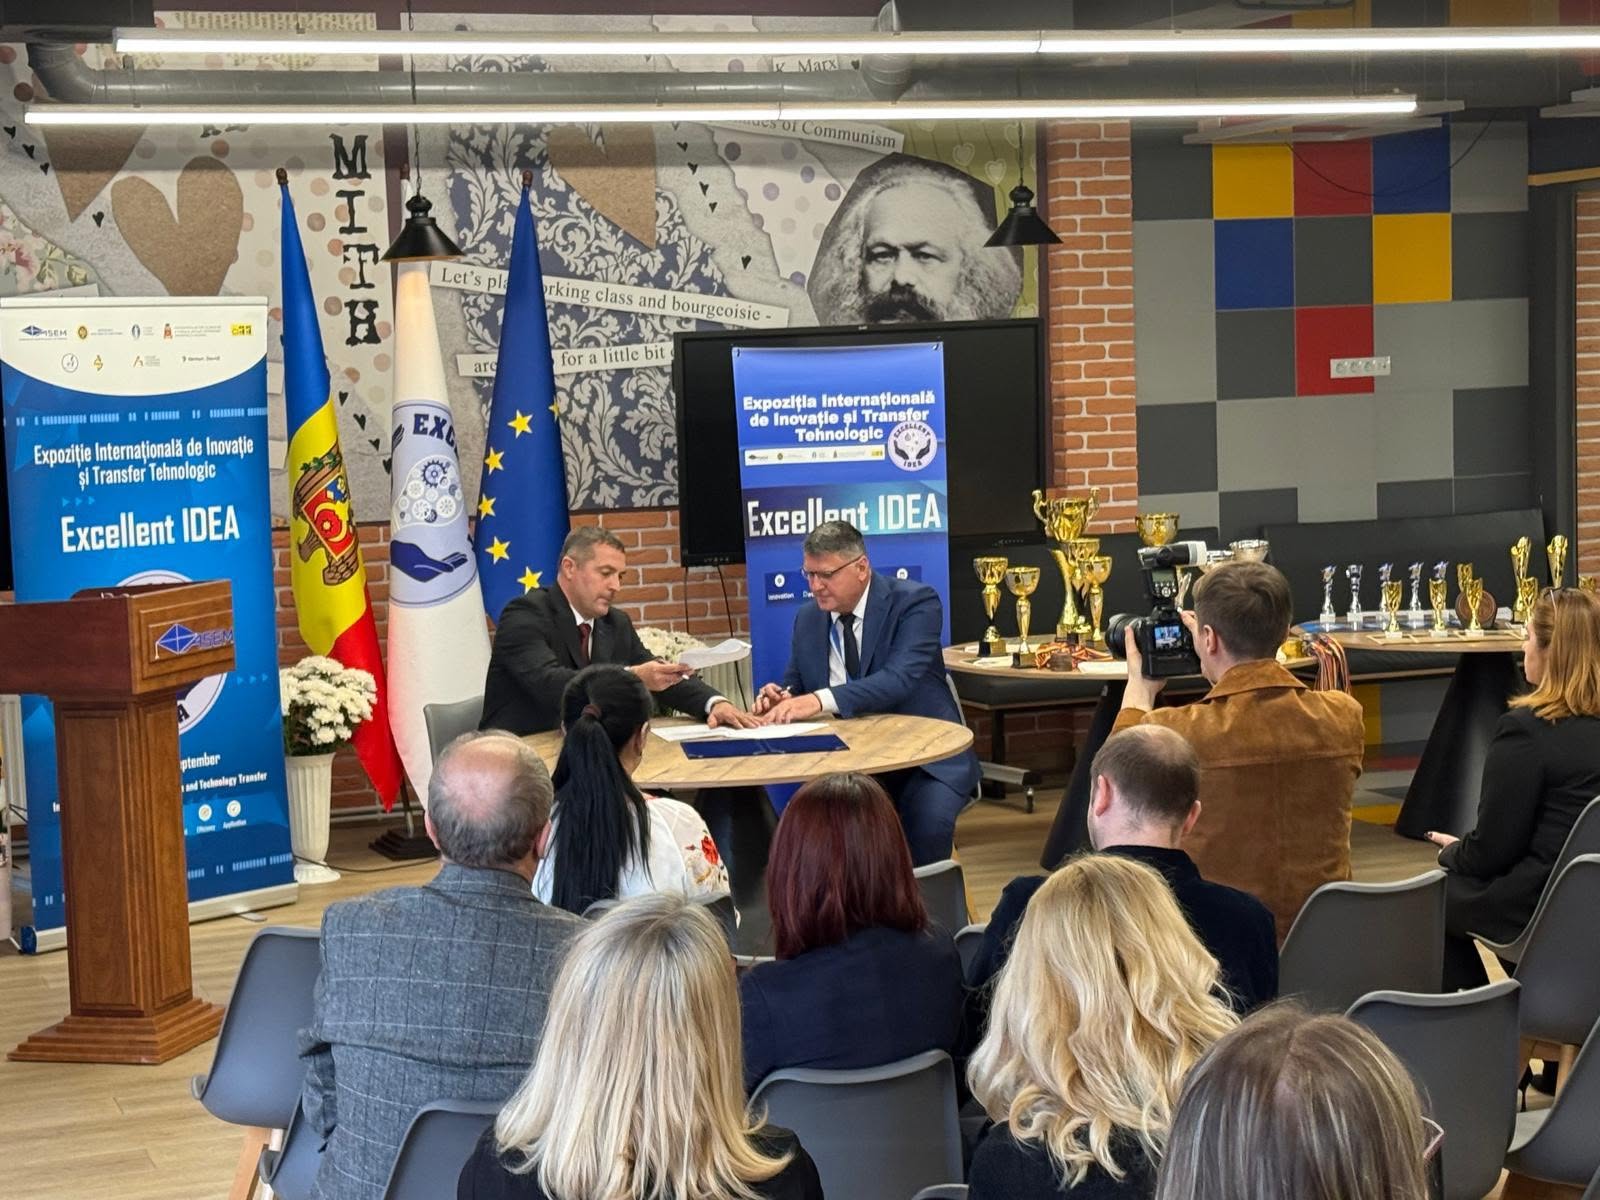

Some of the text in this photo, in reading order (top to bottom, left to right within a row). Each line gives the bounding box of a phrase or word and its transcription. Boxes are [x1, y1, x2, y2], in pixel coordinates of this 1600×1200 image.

[798, 59, 837, 72] Marx
[801, 121, 896, 148] Communism
[328, 133, 381, 346] MITH
[441, 267, 482, 286] Let's
[595, 287, 633, 306] class
[638, 294, 666, 310] and
[672, 296, 760, 321] bourgeoisie
[561, 351, 584, 367] for
[589, 353, 597, 364] a
[603, 347, 639, 363] little
[644, 345, 665, 361] bit
[822, 390, 935, 409] Internațională
[750, 413, 769, 428] de
[773, 411, 839, 429] Inovație
[862, 408, 929, 423] Transfer
[795, 426, 884, 443] Tehnologic
[893, 423, 932, 438] EXCELLENT
[95, 438, 183, 465] Internațională
[186, 438, 203, 456] de
[206, 435, 254, 460] Inovație
[92, 464, 146, 485] Transfer
[149, 460, 216, 482] Tehnologic
[903, 460, 922, 468] IDEA
[747, 493, 942, 537] Excellent IDEA
[60, 504, 240, 553] Excellent IDEA
[185, 780, 198, 792] and
[199, 776, 237, 788] Technology
[238, 771, 268, 784] Transfer
